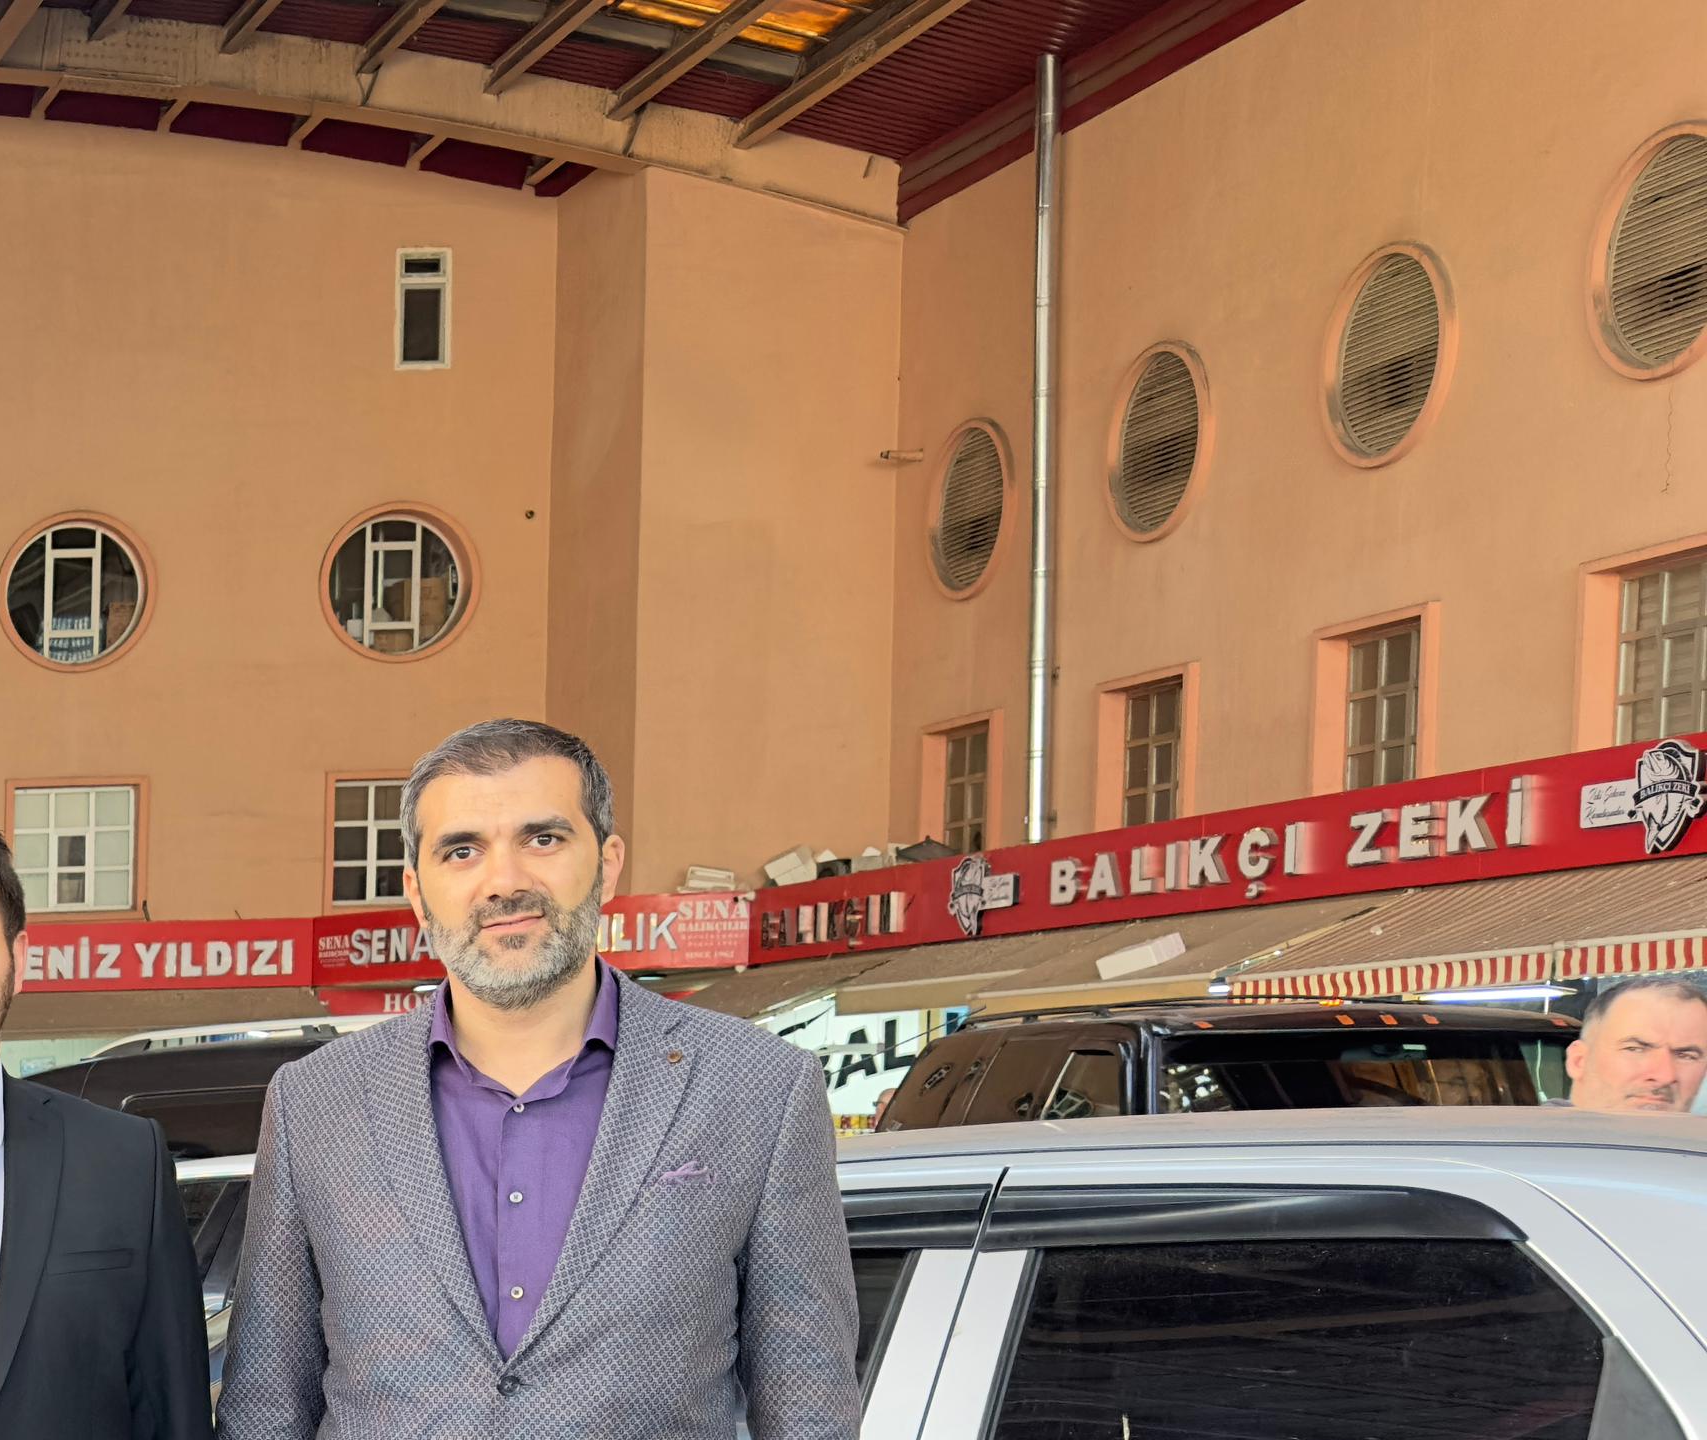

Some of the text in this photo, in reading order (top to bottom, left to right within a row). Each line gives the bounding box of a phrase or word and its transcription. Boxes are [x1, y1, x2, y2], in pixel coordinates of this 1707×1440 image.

[1050, 775, 1531, 905] BALIKÇI ZEKİ
[678, 899, 748, 920] SENA
[24, 936, 295, 981] ENİZ YILDIZI
[318, 934, 349, 951] SENA
[348, 927, 440, 966] SENA
